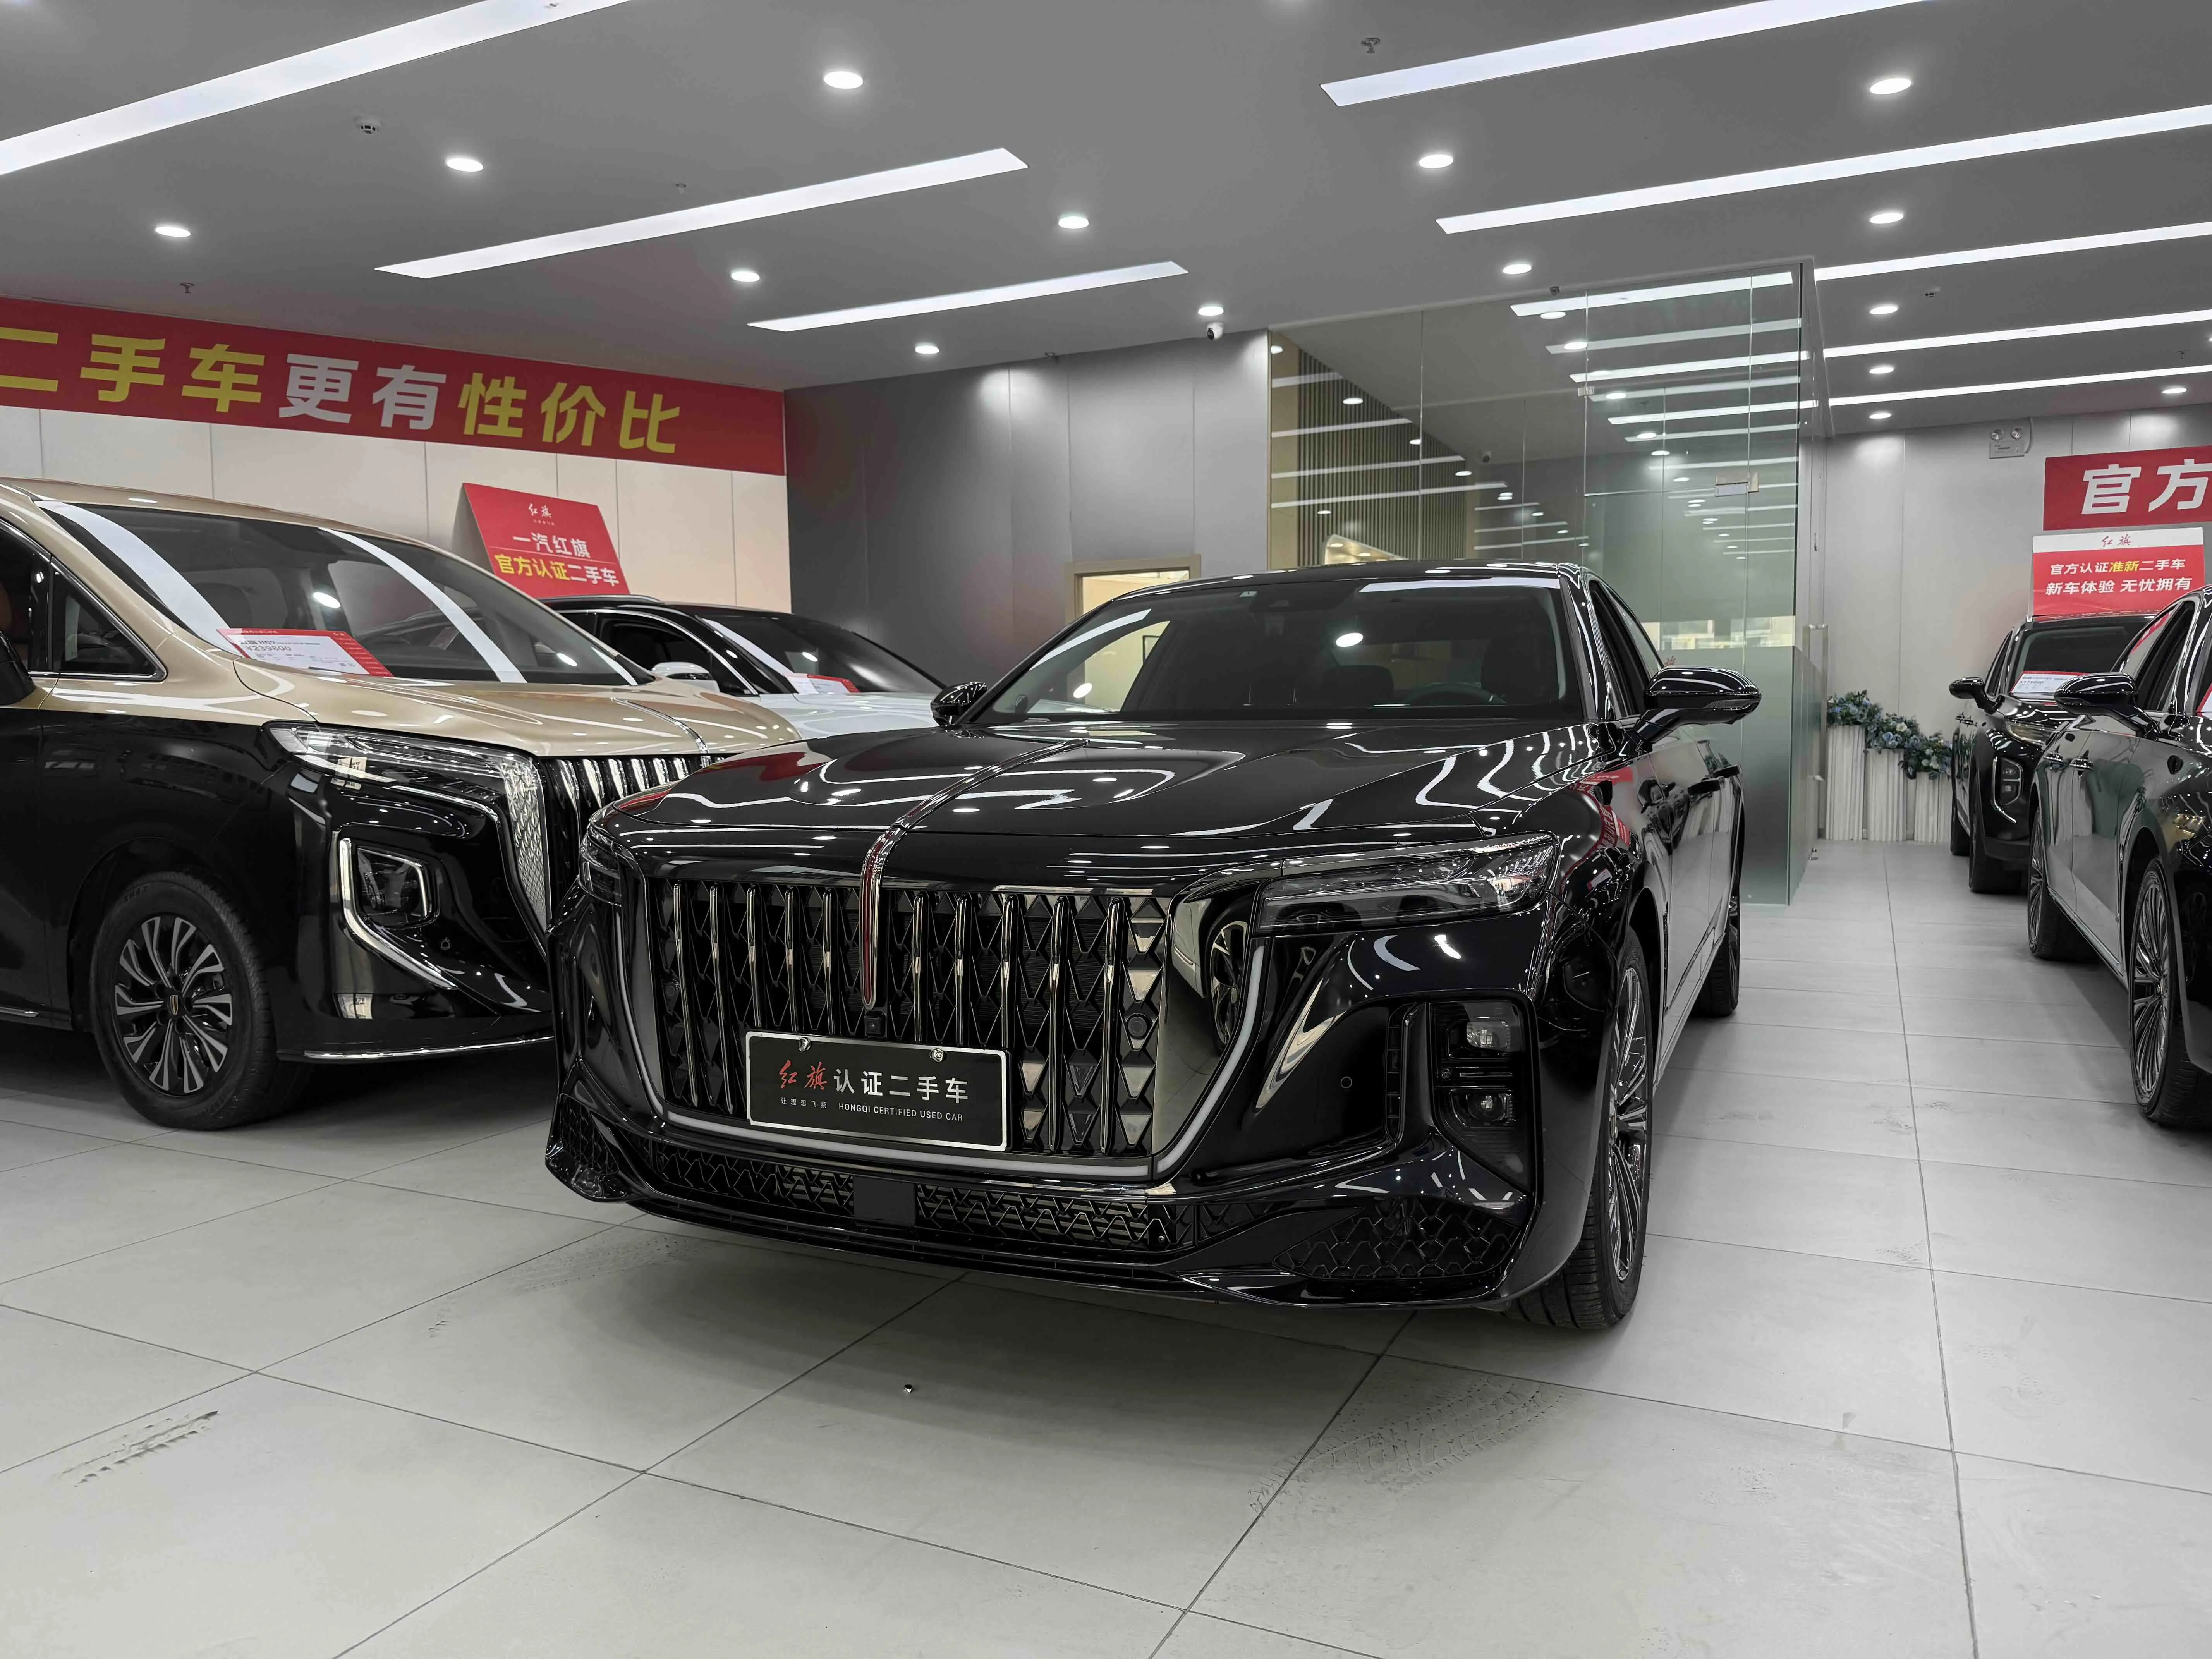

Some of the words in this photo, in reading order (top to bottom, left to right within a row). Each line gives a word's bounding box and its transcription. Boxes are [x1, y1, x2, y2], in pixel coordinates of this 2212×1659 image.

[0, 326, 680, 453] 二手车更有性价比
[2082, 459, 2212, 515] 官方
[528, 503, 551, 518] 红旗
[513, 532, 591, 558] 一汽红旗
[2101, 534, 2131, 547] 红旗
[494, 554, 619, 586] 官方认证二手车
[2051, 558, 2186, 575] 官方认证准新二手车
[2045, 580, 2115, 596] 新车体验
[2120, 577, 2192, 592] 无忧拥有
[781, 1097, 827, 1109] 让理想飞扬
[839, 1103, 870, 1113] HONGQI
[874, 1106, 916, 1117] CERTIFIED
[919, 1110, 942, 1119] USED
[946, 1113, 963, 1121] CAR
